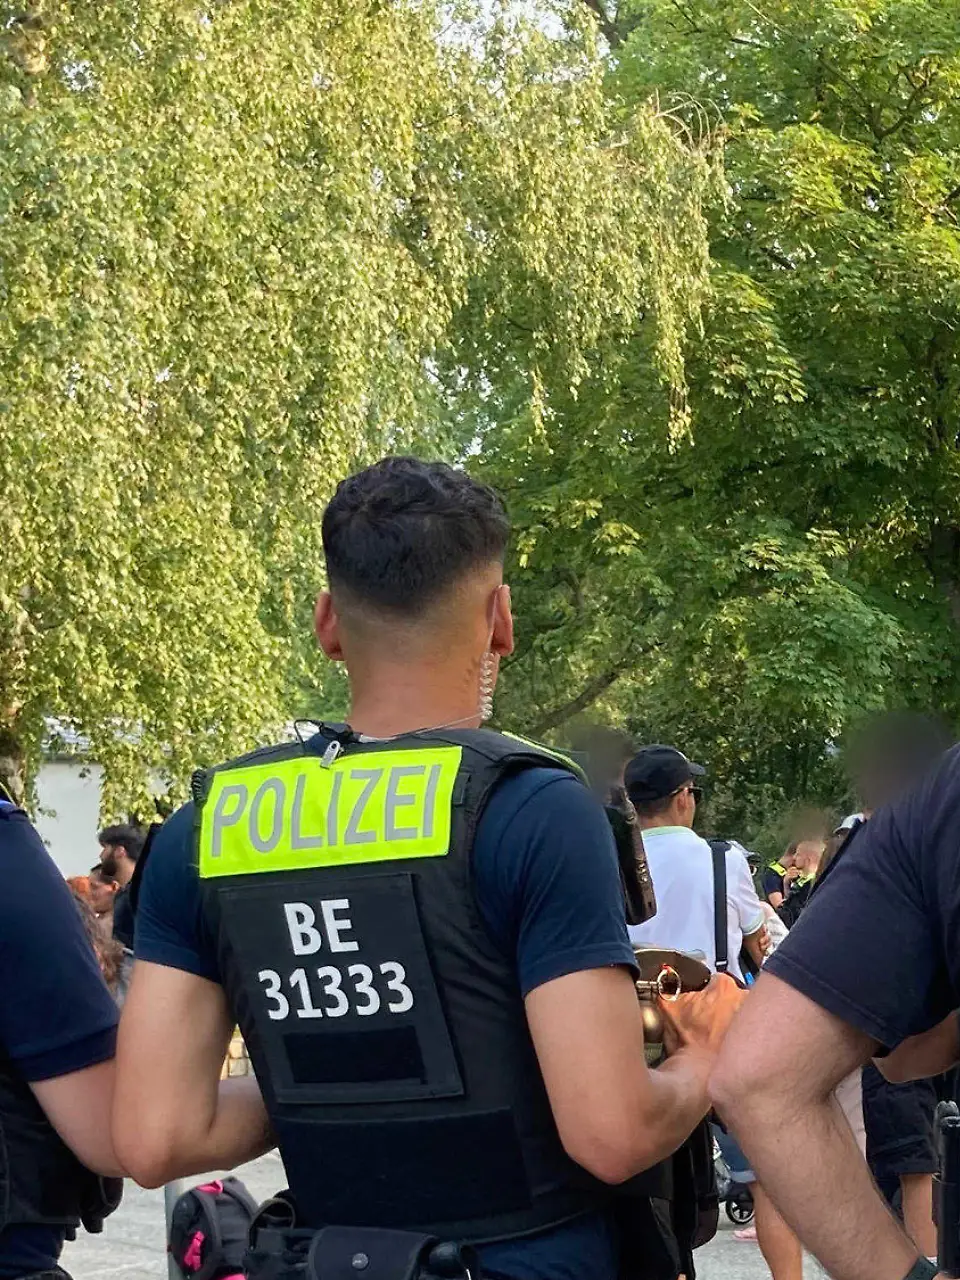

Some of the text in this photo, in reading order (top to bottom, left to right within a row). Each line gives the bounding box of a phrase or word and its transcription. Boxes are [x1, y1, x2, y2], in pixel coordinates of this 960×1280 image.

[211, 763, 443, 858] POLIZEI
[283, 898, 360, 956] BE
[257, 960, 414, 1021] 31333
